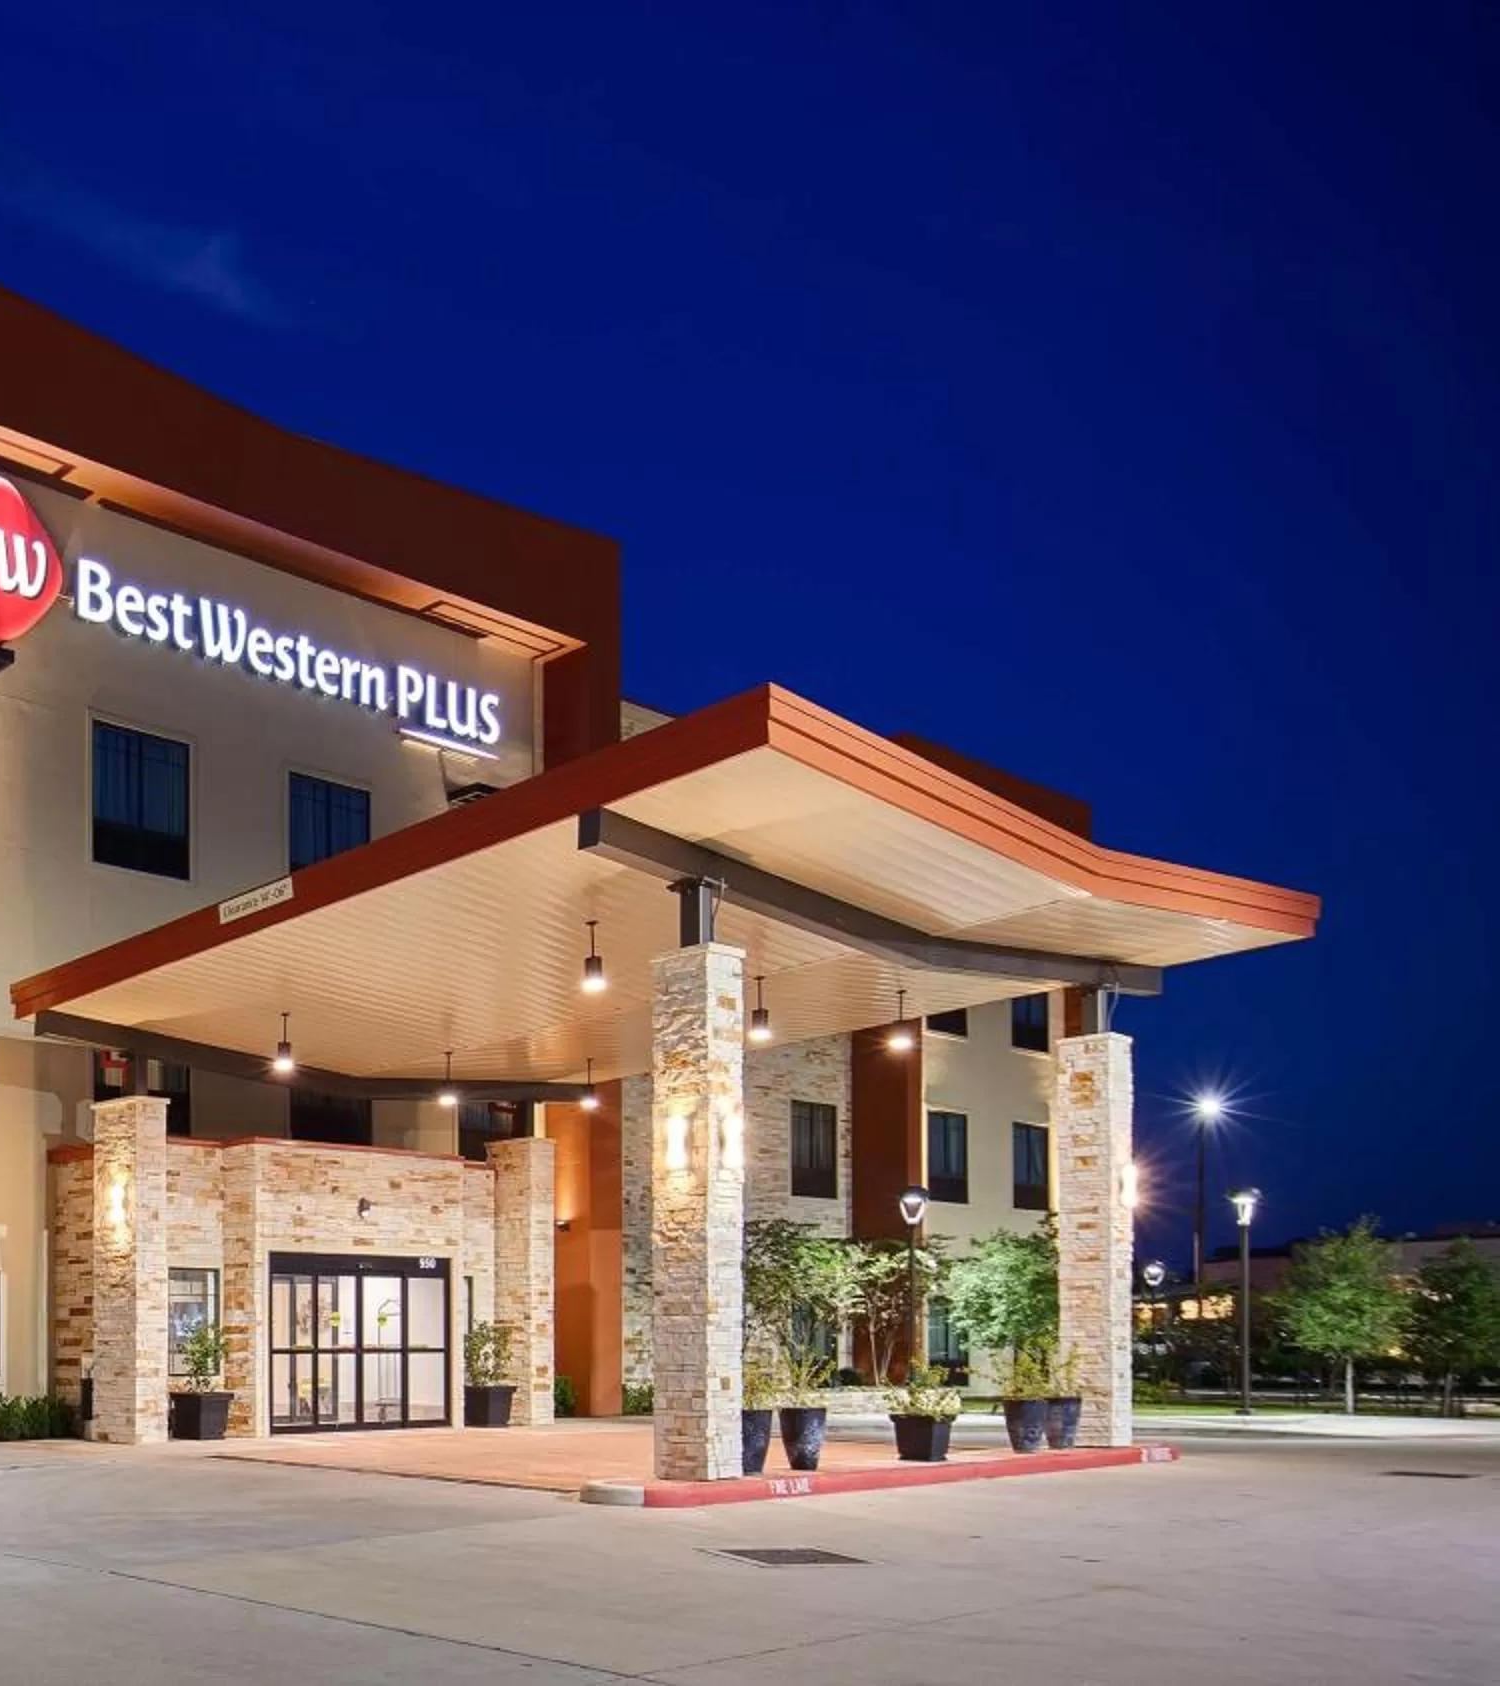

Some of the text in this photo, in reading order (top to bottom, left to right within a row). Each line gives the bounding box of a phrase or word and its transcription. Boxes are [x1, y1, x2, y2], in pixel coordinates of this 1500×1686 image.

[77, 557, 500, 744] Best Western PLUS
